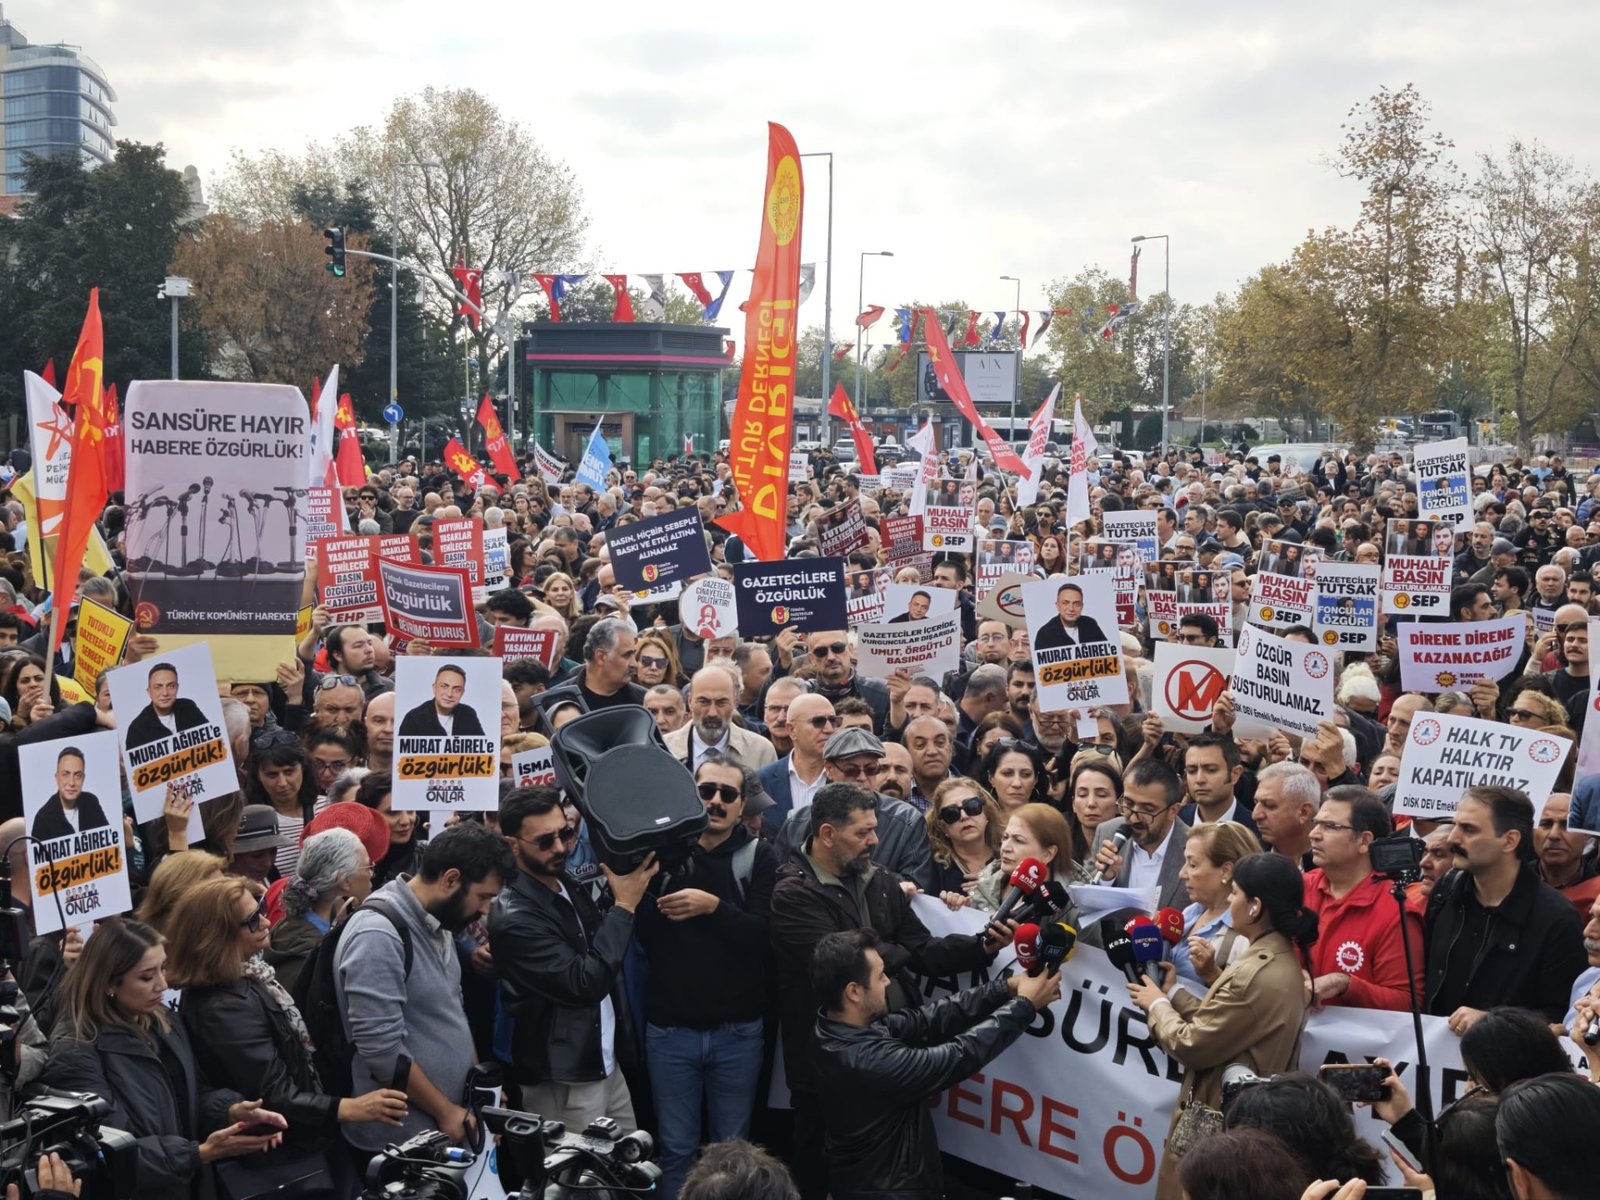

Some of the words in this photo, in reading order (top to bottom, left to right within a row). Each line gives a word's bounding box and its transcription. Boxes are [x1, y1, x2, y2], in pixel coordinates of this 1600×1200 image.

[131, 408, 236, 433] SANSÜRE
[241, 415, 304, 435] HAYIR
[131, 439, 202, 456] HABERE
[206, 437, 304, 459] ÖZGÜRLÜK!
[1416, 453, 1466, 467] GAZETECİLER
[1418, 461, 1466, 478] TUTSAK
[1421, 485, 1466, 498] FONCULAR
[1426, 495, 1464, 509] ÖZGÜR!
[927, 507, 973, 519] MUHALİF
[930, 517, 969, 528] BASIN
[1105, 521, 1156, 529] GAZETECİLER
[610, 534, 637, 548] BASIN,
[664, 516, 698, 532] SEBEPLE
[1106, 528, 1156, 538] TUTSAK
[616, 544, 639, 556] BASKI
[640, 540, 651, 549] VE
[652, 535, 669, 546] ETKİ
[670, 528, 697, 541] ALTINA
[944, 536, 966, 546] SEP
[328, 550, 369, 562] YASAKLAR
[381, 545, 410, 556] ASAKLAR
[445, 552, 465, 563] BASIN
[638, 543, 679, 560] ALINAMAZ
[328, 560, 370, 573] YENİLECEK
[1388, 557, 1450, 571] MUHALİF
[337, 572, 362, 584] BASIN
[485, 576, 504, 586] SEP
[742, 570, 837, 588] GAZETECİLERE
[1259, 573, 1315, 593] MUHALİF
[1316, 575, 1378, 585] GAZETECİLER
[1393, 569, 1444, 584] BASIN
[386, 582, 452, 612] Özgürlük
[755, 586, 826, 603] ÖZGÜRLÜK
[1261, 585, 1309, 604] BASIN
[1317, 583, 1377, 596] TUTSAK
[1411, 595, 1440, 607] SEP
[166, 609, 206, 620] TÜRKİYE
[207, 610, 254, 620] KOMÜNİST
[335, 611, 365, 623] EHP
[1179, 604, 1230, 617] MUHALİF
[1274, 610, 1302, 623] SEP
[1318, 605, 1373, 616] FONCULAR
[87, 615, 116, 639] TUTUKLU
[1323, 615, 1369, 627] ÖZGÜR!
[433, 626, 466, 640] DURUŞ
[861, 636, 920, 646] VURGUNCULAR
[921, 627, 958, 641] DIŞARIDA!
[863, 628, 922, 639] GAZETECİLER
[1339, 632, 1367, 644] SEP
[1409, 630, 1462, 646] DİRENE
[1464, 627, 1515, 646] DİRENE
[79, 627, 117, 657] GAZETECİLER
[504, 643, 543, 653] YASAKLAR
[871, 648, 902, 657] UMUT,
[905, 636, 953, 655] ÖRGÜTLÜ
[886, 651, 937, 665] BASINDA!
[1036, 647, 1072, 665] MURAT
[1256, 638, 1293, 667] ÖZGÜR
[1413, 645, 1514, 664] KAZANACAĞIZ
[1043, 657, 1118, 682] özgürlük!
[1256, 663, 1290, 688] BASIN
[1067, 689, 1100, 701] ONLAR
[1231, 674, 1325, 717] SUSTURULAMAZ.
[399, 738, 442, 754] MURAT
[1446, 726, 1494, 748] HALK
[1499, 734, 1523, 752] TV
[129, 740, 170, 767] MURAT
[1439, 747, 1514, 772] HALKTIR
[138, 740, 223, 787] özgürlük!
[401, 755, 493, 778] özgürlük!
[426, 791, 465, 804] ONLAR
[1403, 796, 1420, 809] DİSK
[1421, 798, 1435, 810] DEV
[33, 838, 71, 865] MURAT
[39, 847, 119, 891] özgürlük!
[1019, 873, 1037, 889] anka
[65, 895, 101, 916] ONLAR
